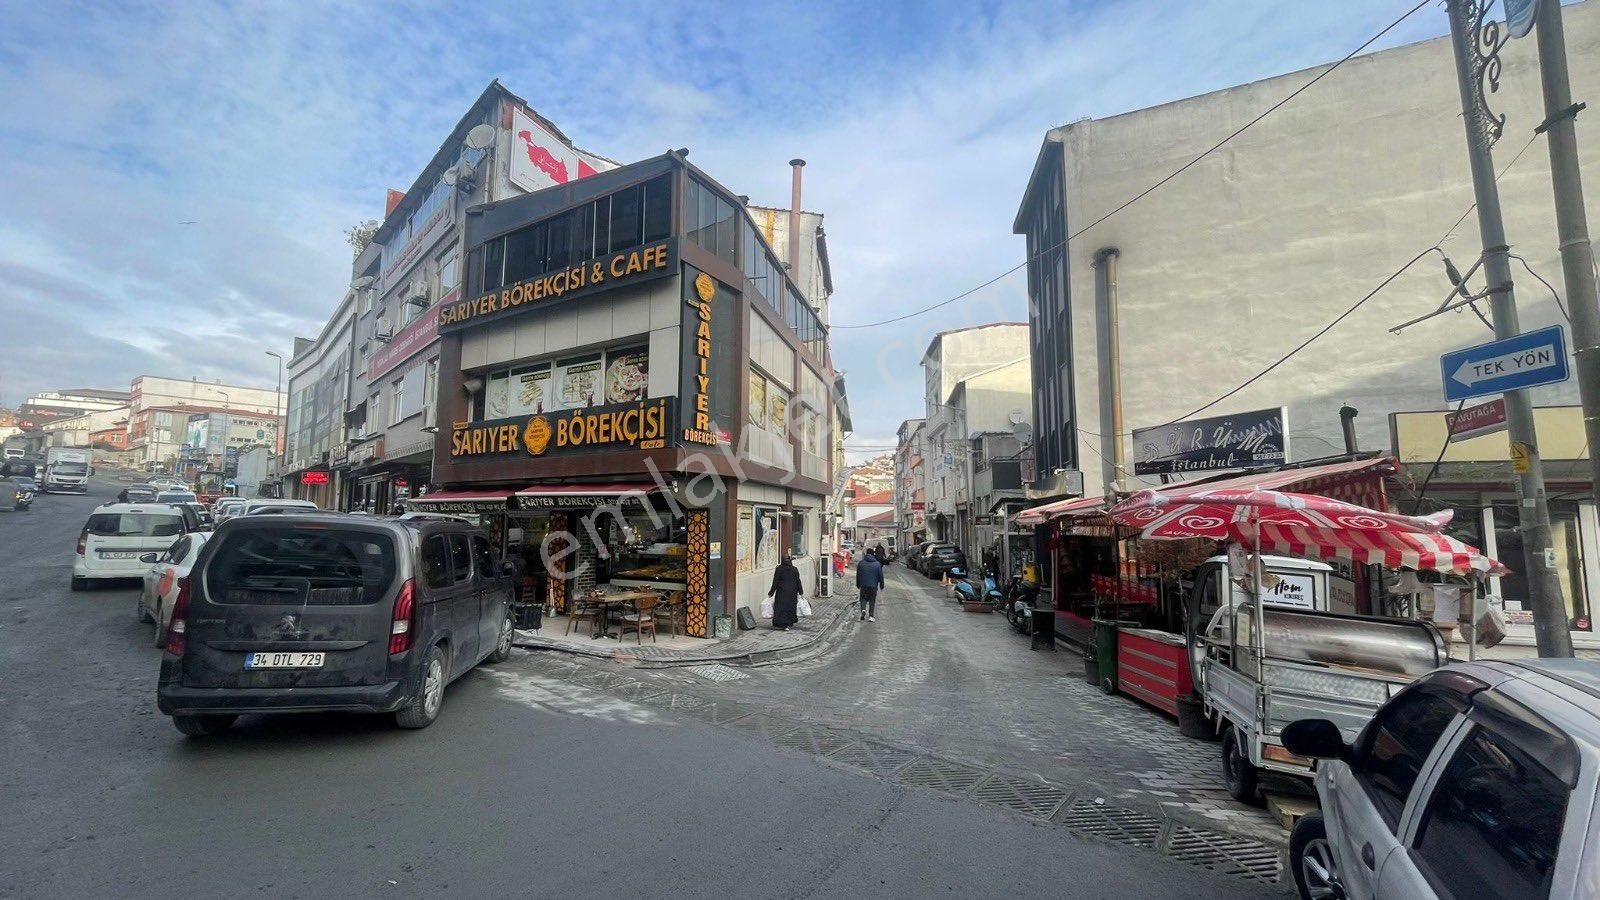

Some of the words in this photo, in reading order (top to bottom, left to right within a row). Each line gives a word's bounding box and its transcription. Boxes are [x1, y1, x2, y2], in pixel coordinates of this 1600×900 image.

[439, 296, 497, 326] SARIYER
[501, 262, 586, 310] BÖREKÇİSİ
[591, 261, 604, 284] &
[610, 244, 668, 278] CAFE
[696, 302, 712, 431] SARIYER
[1474, 360, 1505, 377] TEK
[1513, 350, 1551, 368] YÖN
[452, 424, 519, 457] SARIYER
[557, 400, 665, 447] BÖREKÇİSİ
[254, 654, 267, 666] 34
[273, 654, 293, 666] DTL
[299, 654, 322, 666] 729
